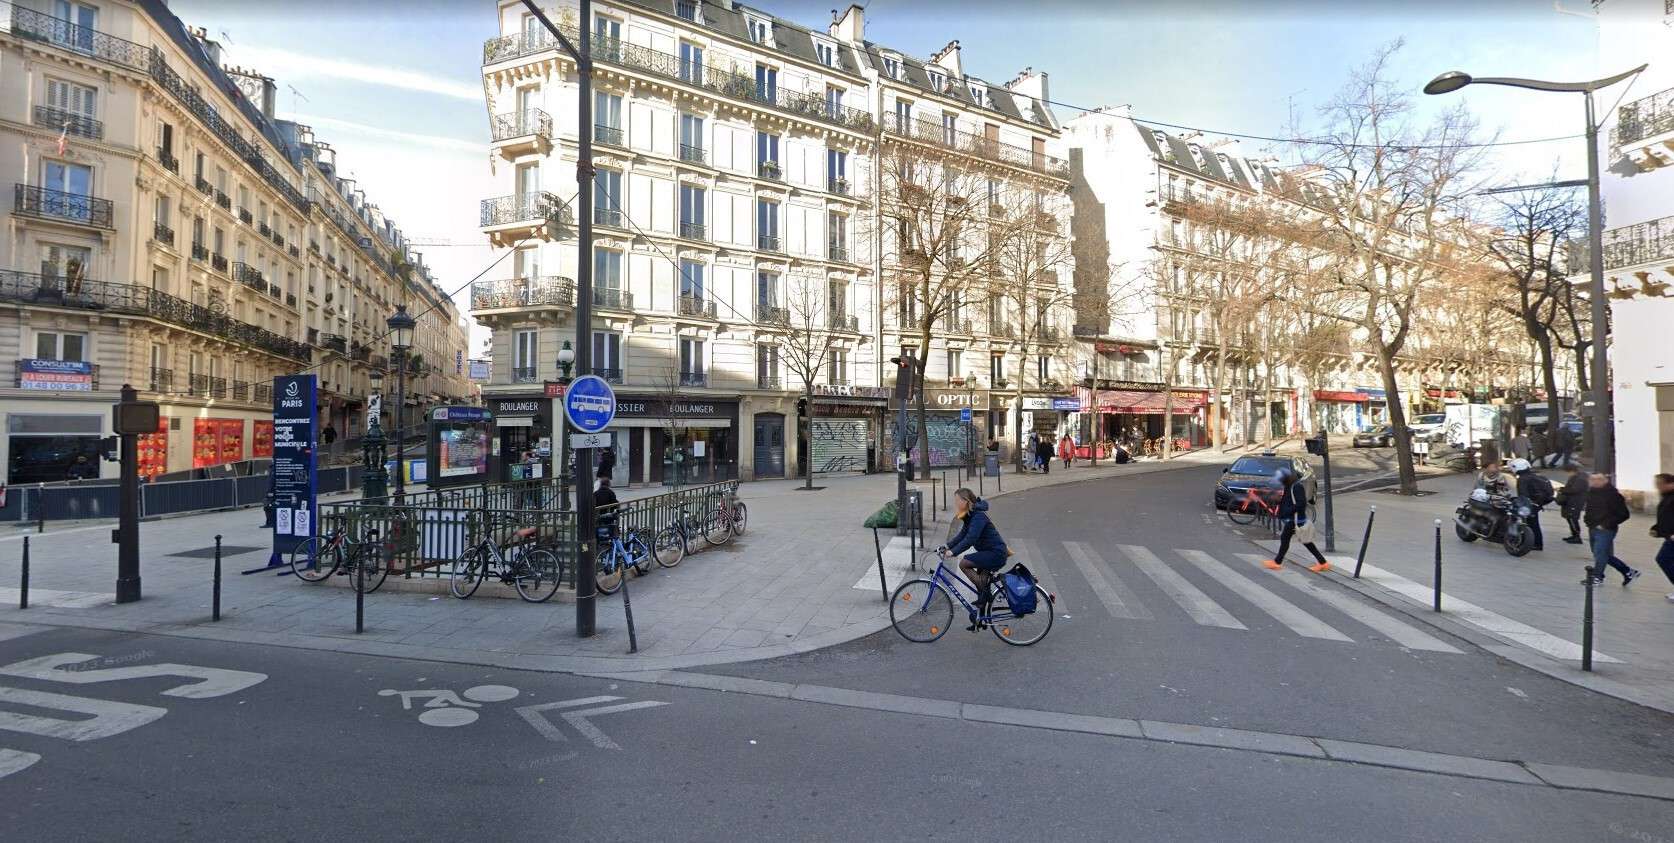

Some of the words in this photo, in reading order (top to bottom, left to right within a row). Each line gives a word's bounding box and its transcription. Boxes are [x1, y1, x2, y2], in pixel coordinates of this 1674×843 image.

[281, 400, 303, 408] PARIS
[937, 394, 980, 405] OPTIC
[500, 402, 539, 411] BOULANGER
[615, 403, 645, 412] SSIER
